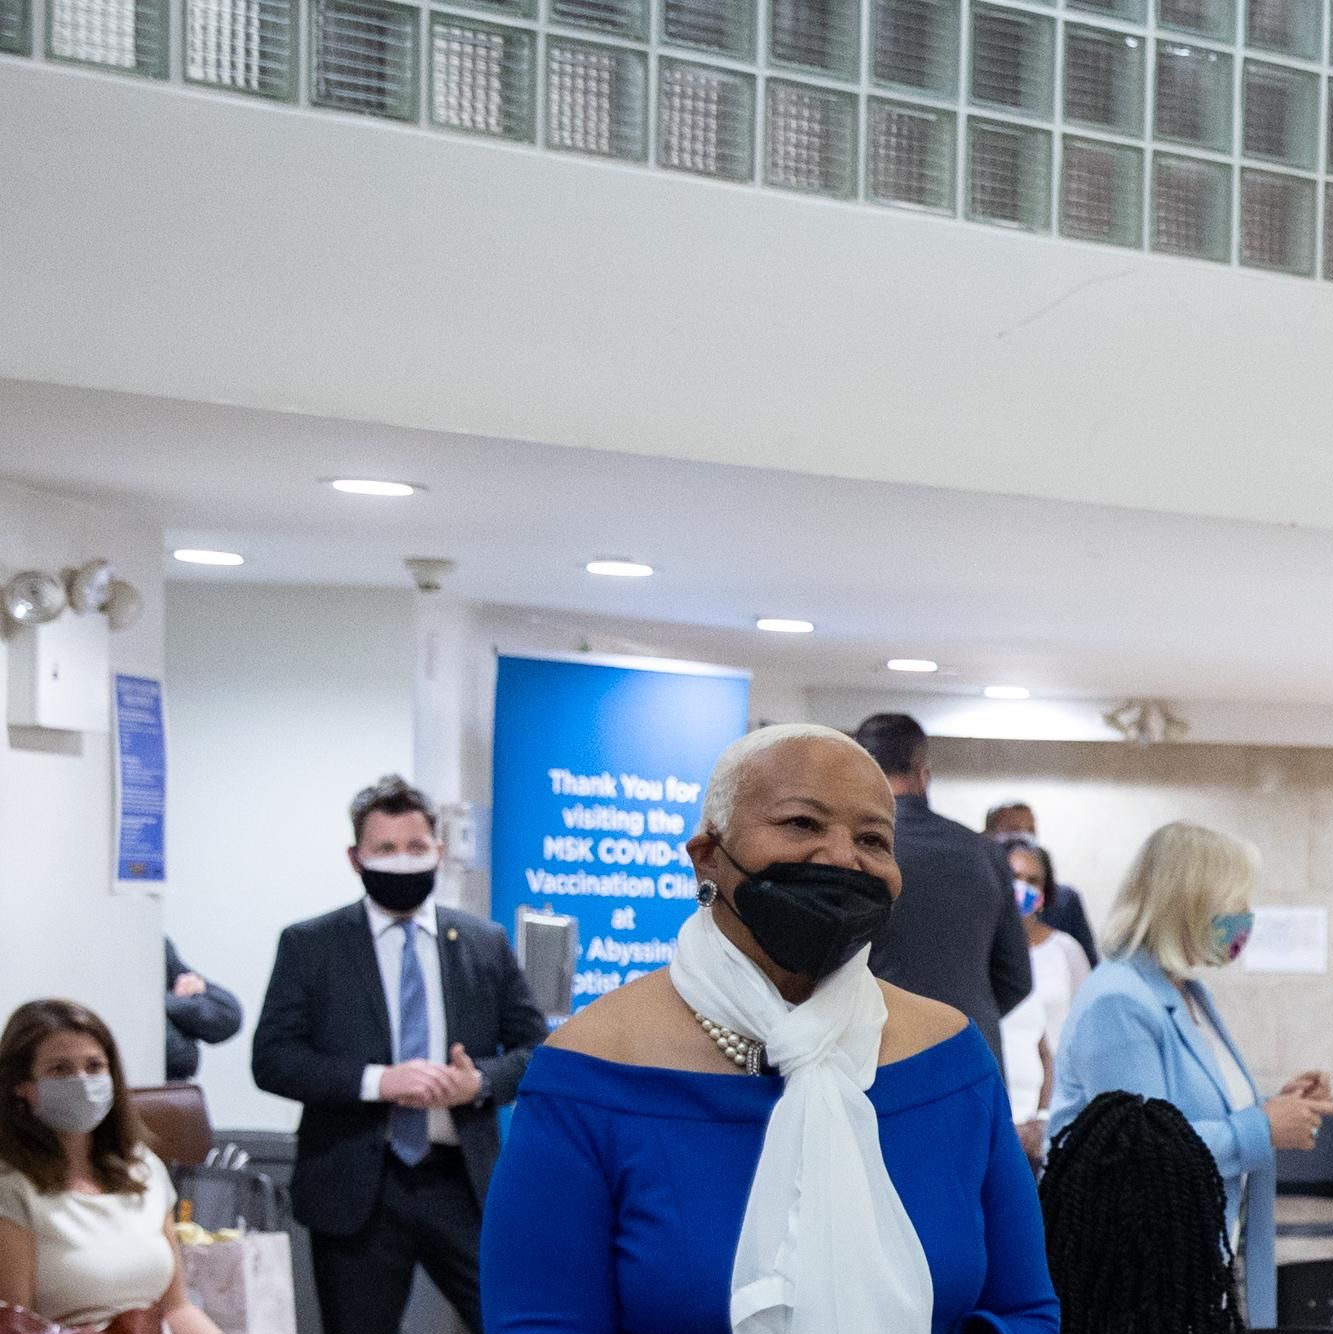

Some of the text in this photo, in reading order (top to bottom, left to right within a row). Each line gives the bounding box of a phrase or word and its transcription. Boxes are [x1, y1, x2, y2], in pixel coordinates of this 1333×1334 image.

[548, 768, 701, 803] Thank You for
[561, 802, 685, 837] visiting the
[542, 835, 694, 867] MSK COVID-1
[525, 867, 654, 898] Vaccination
[611, 905, 636, 931] at
[586, 935, 678, 967] Abyssini
